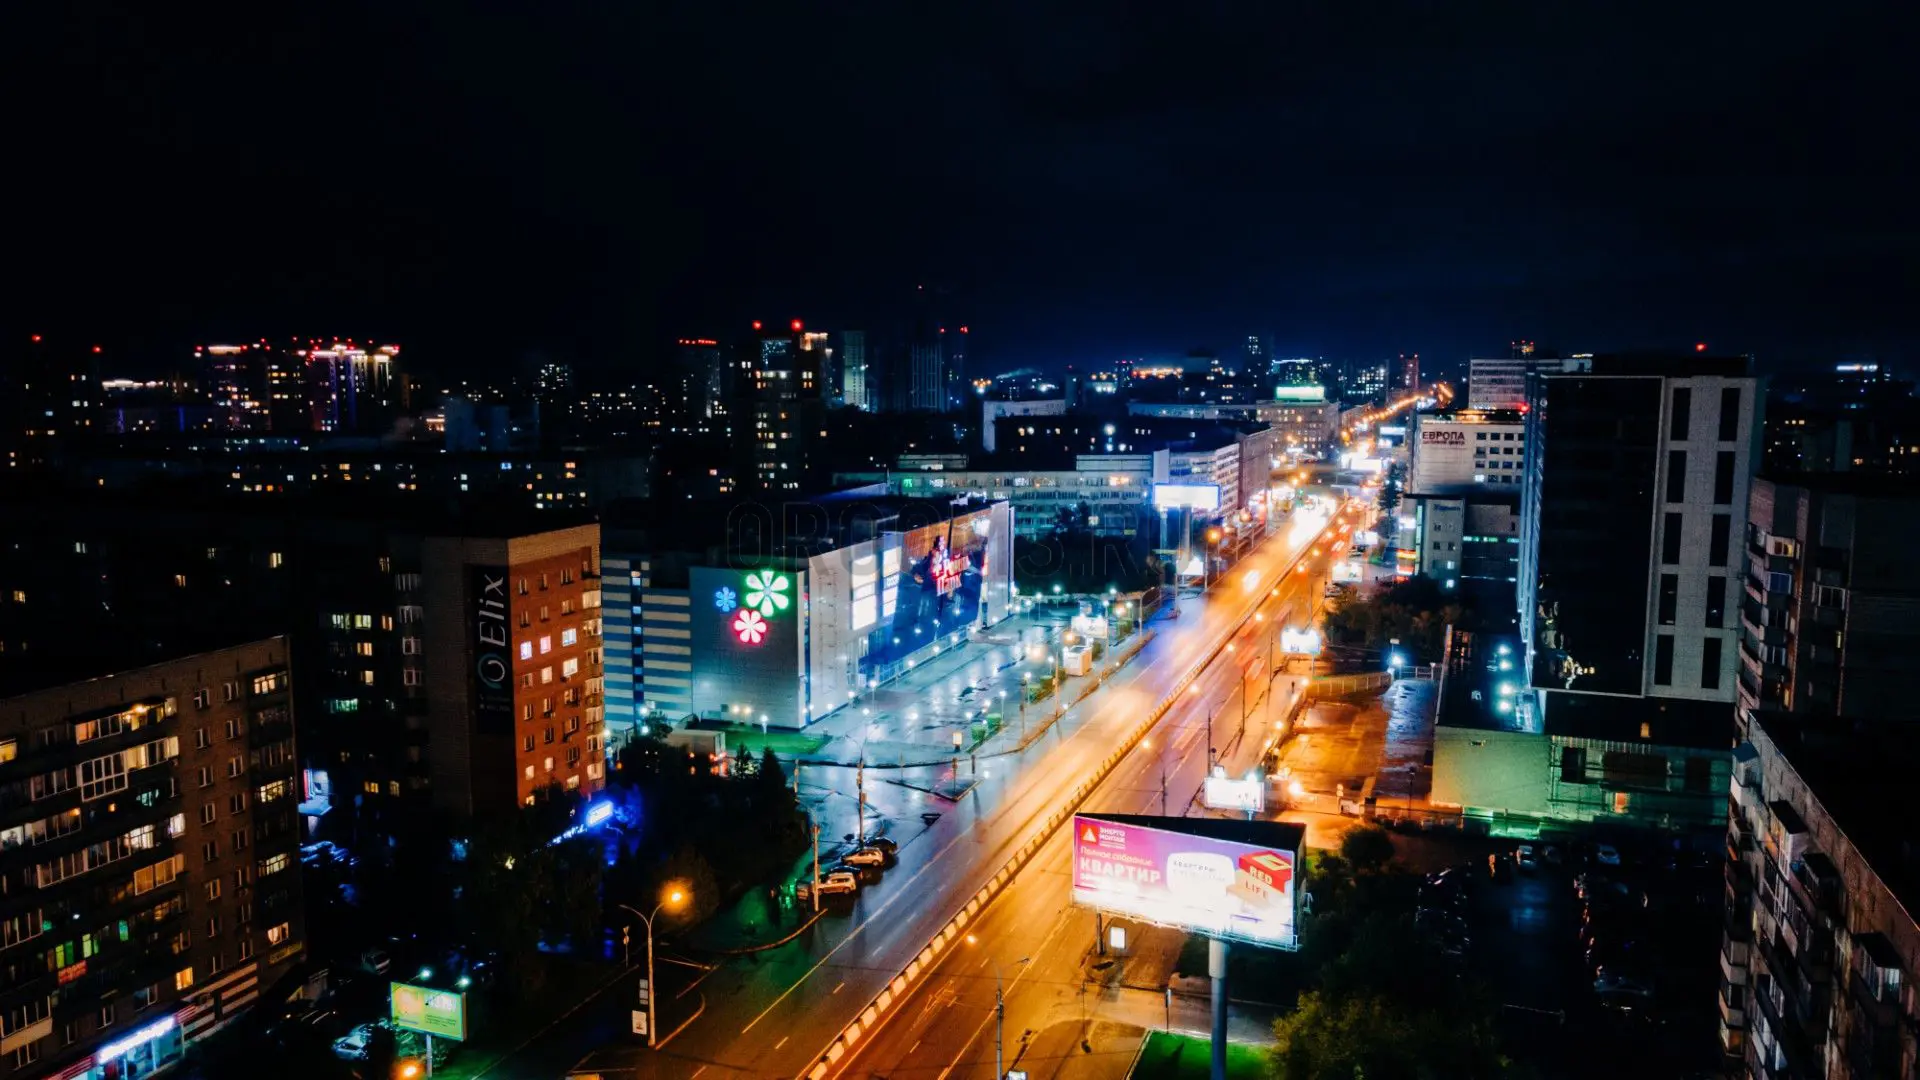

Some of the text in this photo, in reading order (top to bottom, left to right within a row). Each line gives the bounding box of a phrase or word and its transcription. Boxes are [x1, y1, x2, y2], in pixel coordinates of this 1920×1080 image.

[1422, 431, 1465, 441] ЕВРОПА
[1080, 857, 1161, 883] КВАРТИР
[1249, 865, 1273, 886] RED
